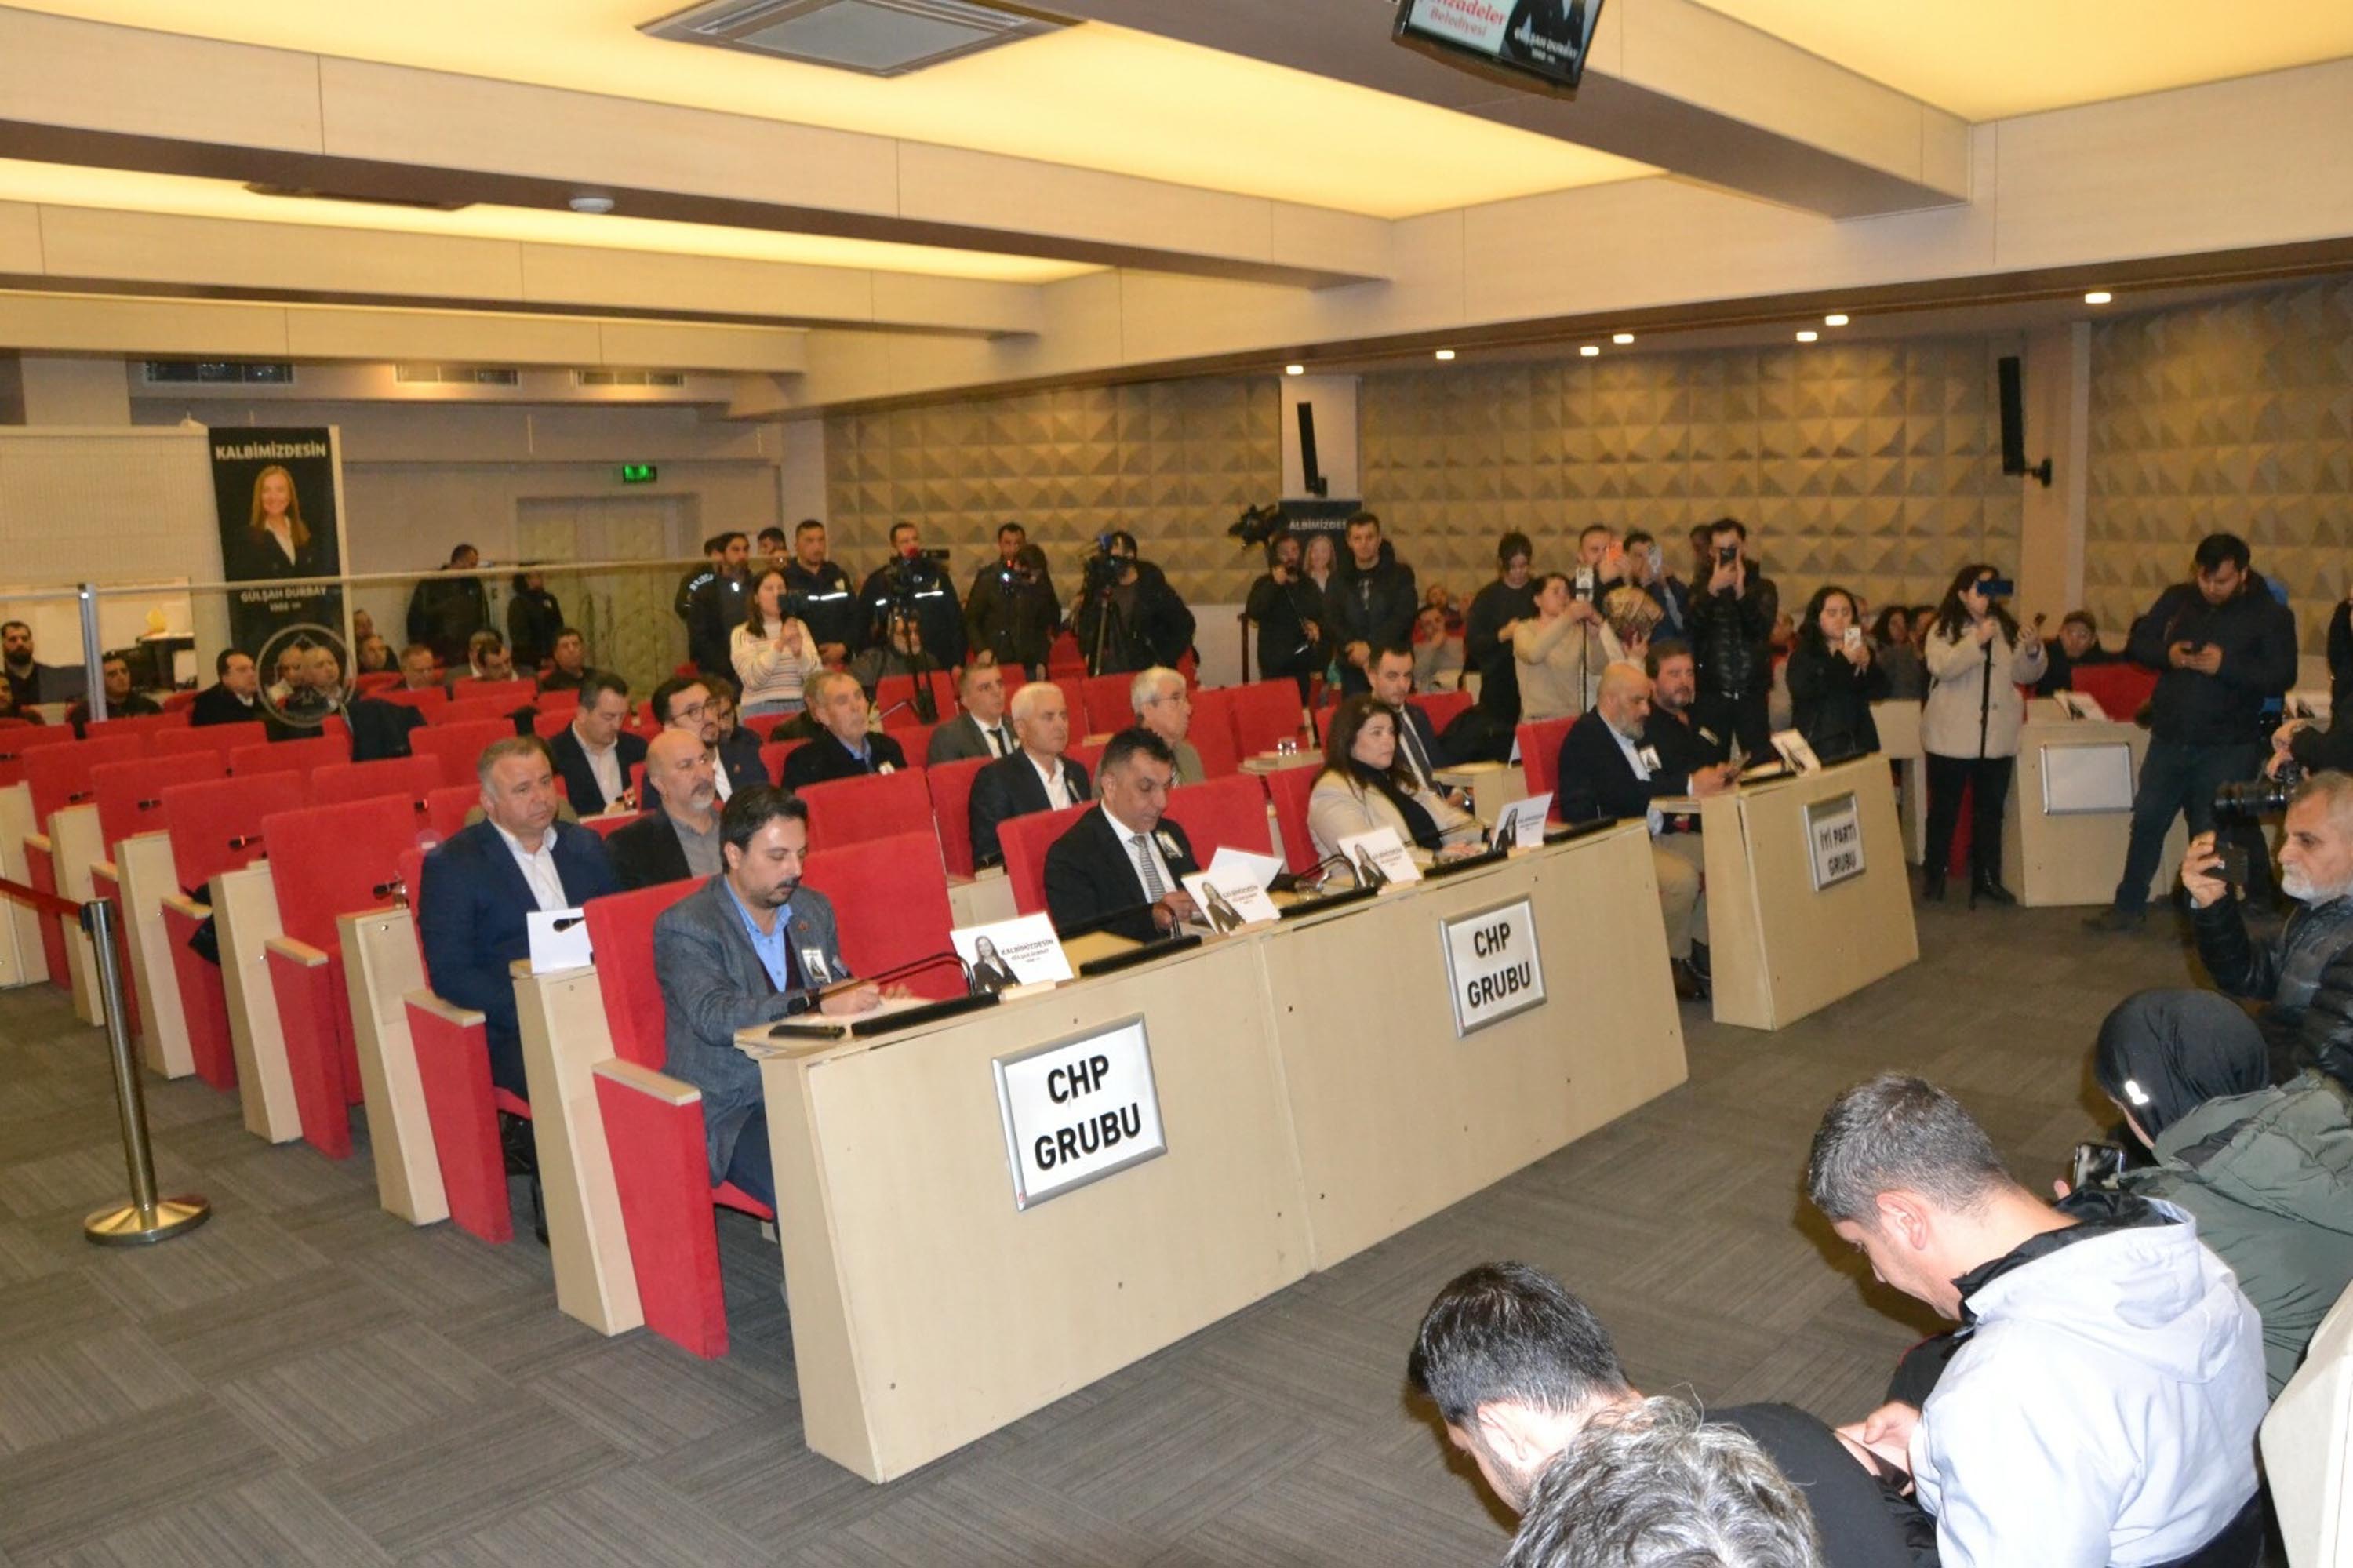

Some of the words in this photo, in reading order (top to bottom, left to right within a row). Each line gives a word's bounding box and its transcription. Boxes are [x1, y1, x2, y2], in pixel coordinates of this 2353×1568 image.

[215, 440, 326, 460] KALBİMİZDESİN
[1827, 850, 1857, 877] GRUBU
[1473, 922, 1511, 959] CHP
[1467, 961, 1531, 1009] GRUBU
[1047, 1054, 1110, 1104] CHP
[1034, 1102, 1142, 1171] GRUBU
